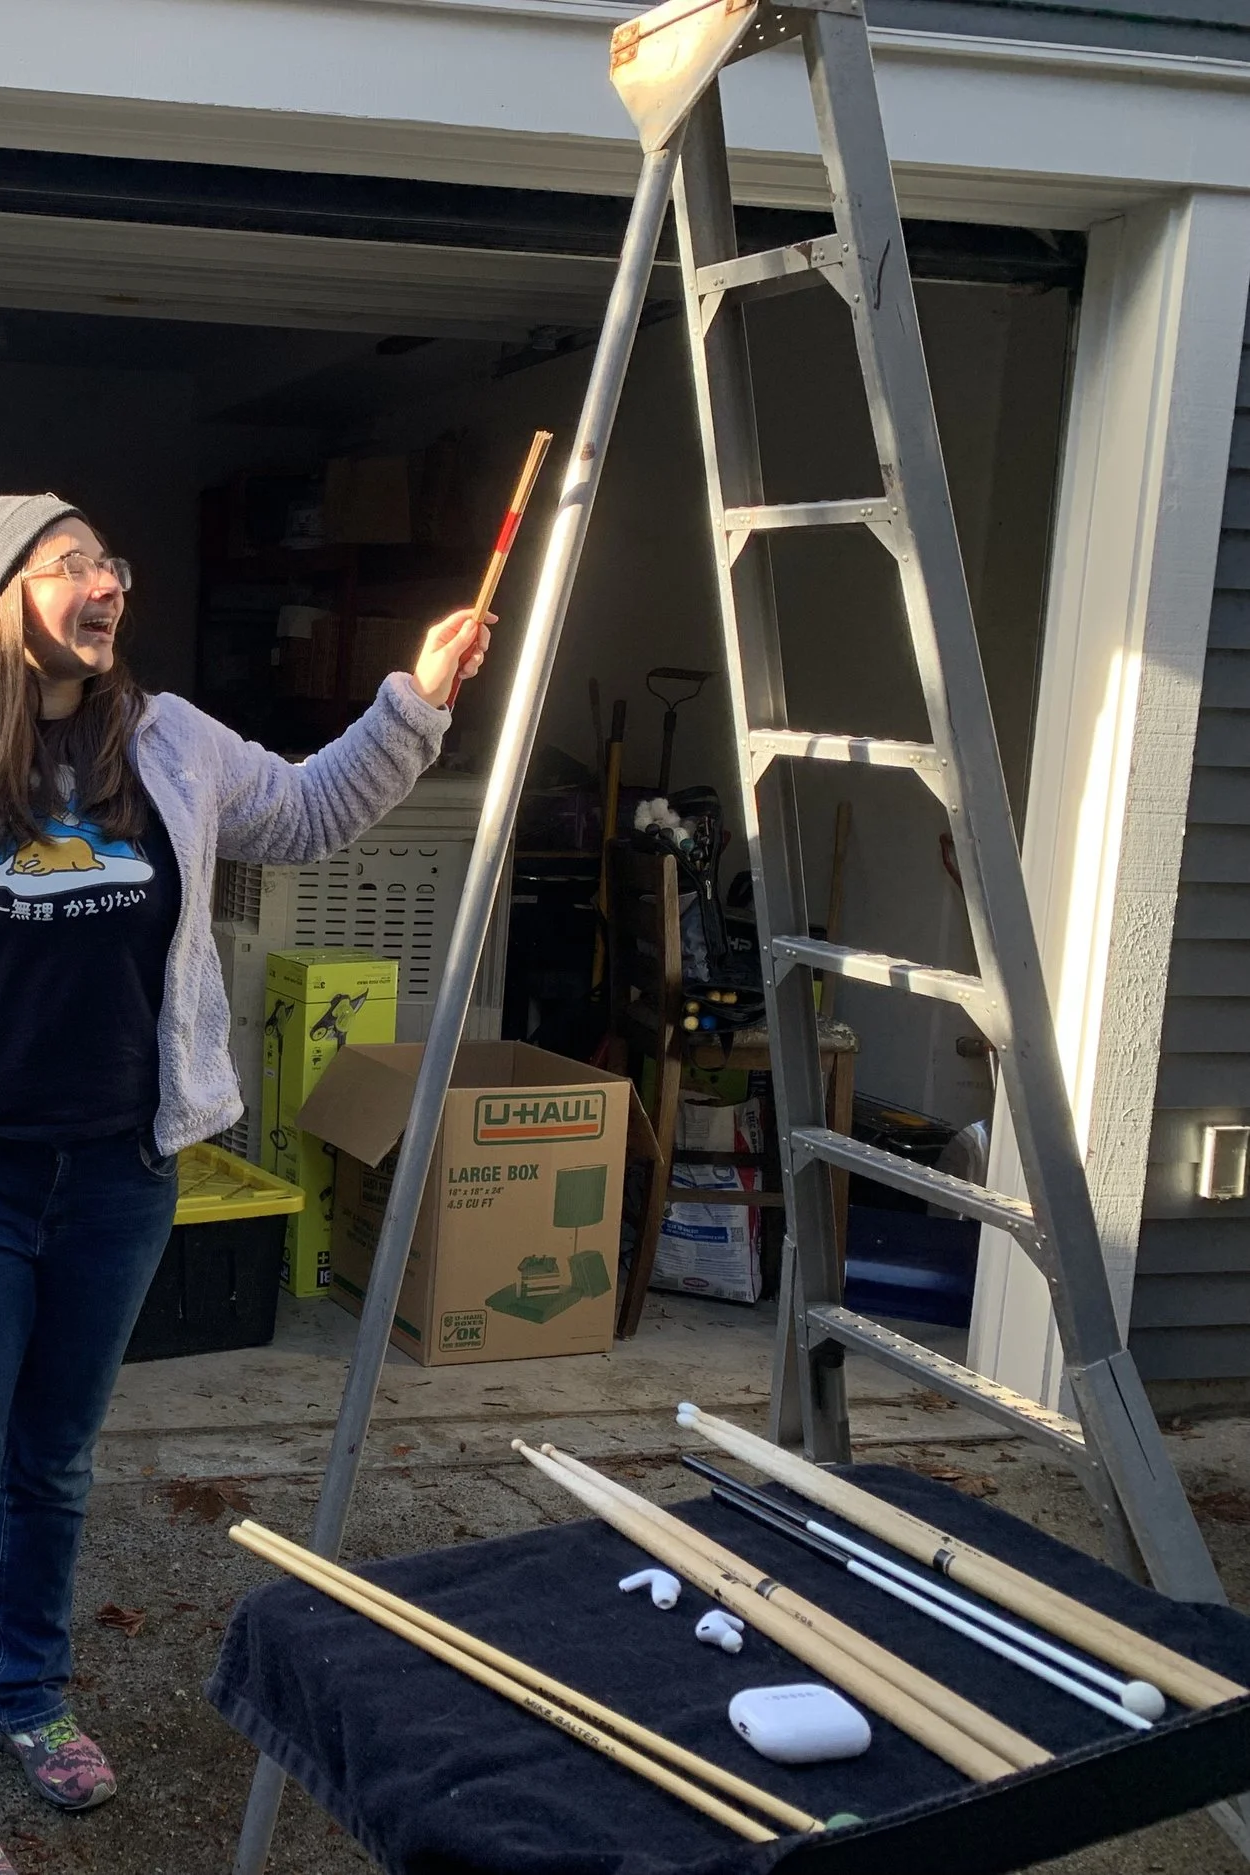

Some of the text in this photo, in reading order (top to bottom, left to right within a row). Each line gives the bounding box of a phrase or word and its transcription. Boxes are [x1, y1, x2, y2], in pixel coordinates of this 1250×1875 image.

[63, 889, 147, 918] かえりたい
[484, 1099, 597, 1125] U-HAUL
[448, 1163, 539, 1184] LARGE BOX
[448, 1187, 462, 1197] 18"
[470, 1187, 484, 1196] 18"
[491, 1186, 504, 1195] 24"
[447, 1198, 494, 1209] 4.5 CU FT
[457, 1327, 481, 1340] OK
[523, 1696, 600, 1745] MIKE BALTER
